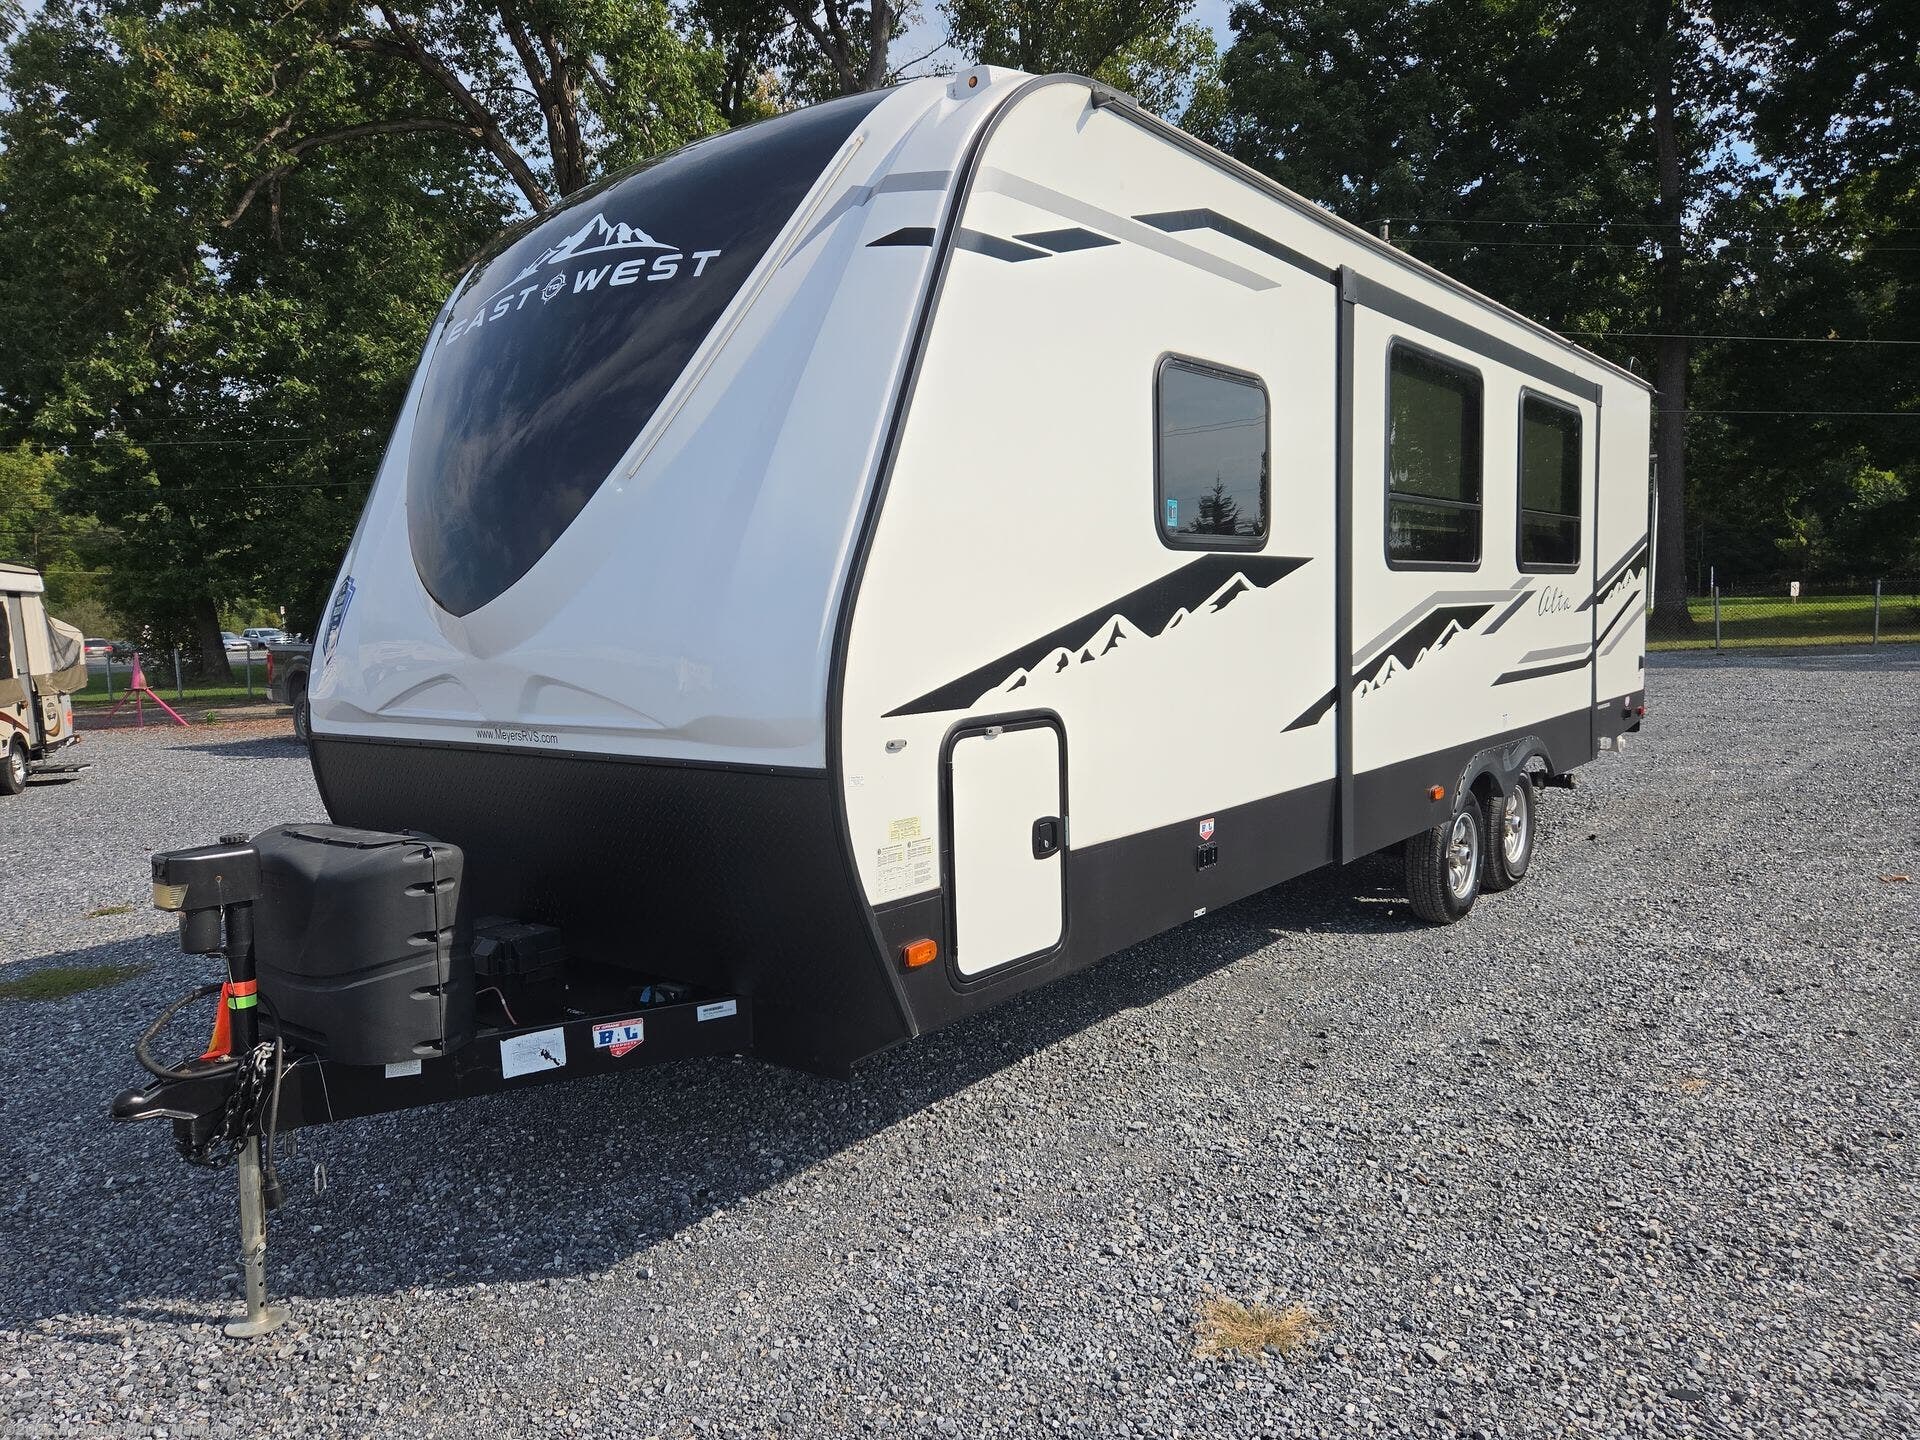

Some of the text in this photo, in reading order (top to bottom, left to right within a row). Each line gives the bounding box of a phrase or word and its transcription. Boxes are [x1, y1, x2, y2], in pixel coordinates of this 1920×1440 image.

[445, 284, 538, 346] EAST
[573, 249, 722, 294] WEST
[475, 728, 559, 744] www.MeyersRVS.com
[598, 1027, 638, 1044] BAL
